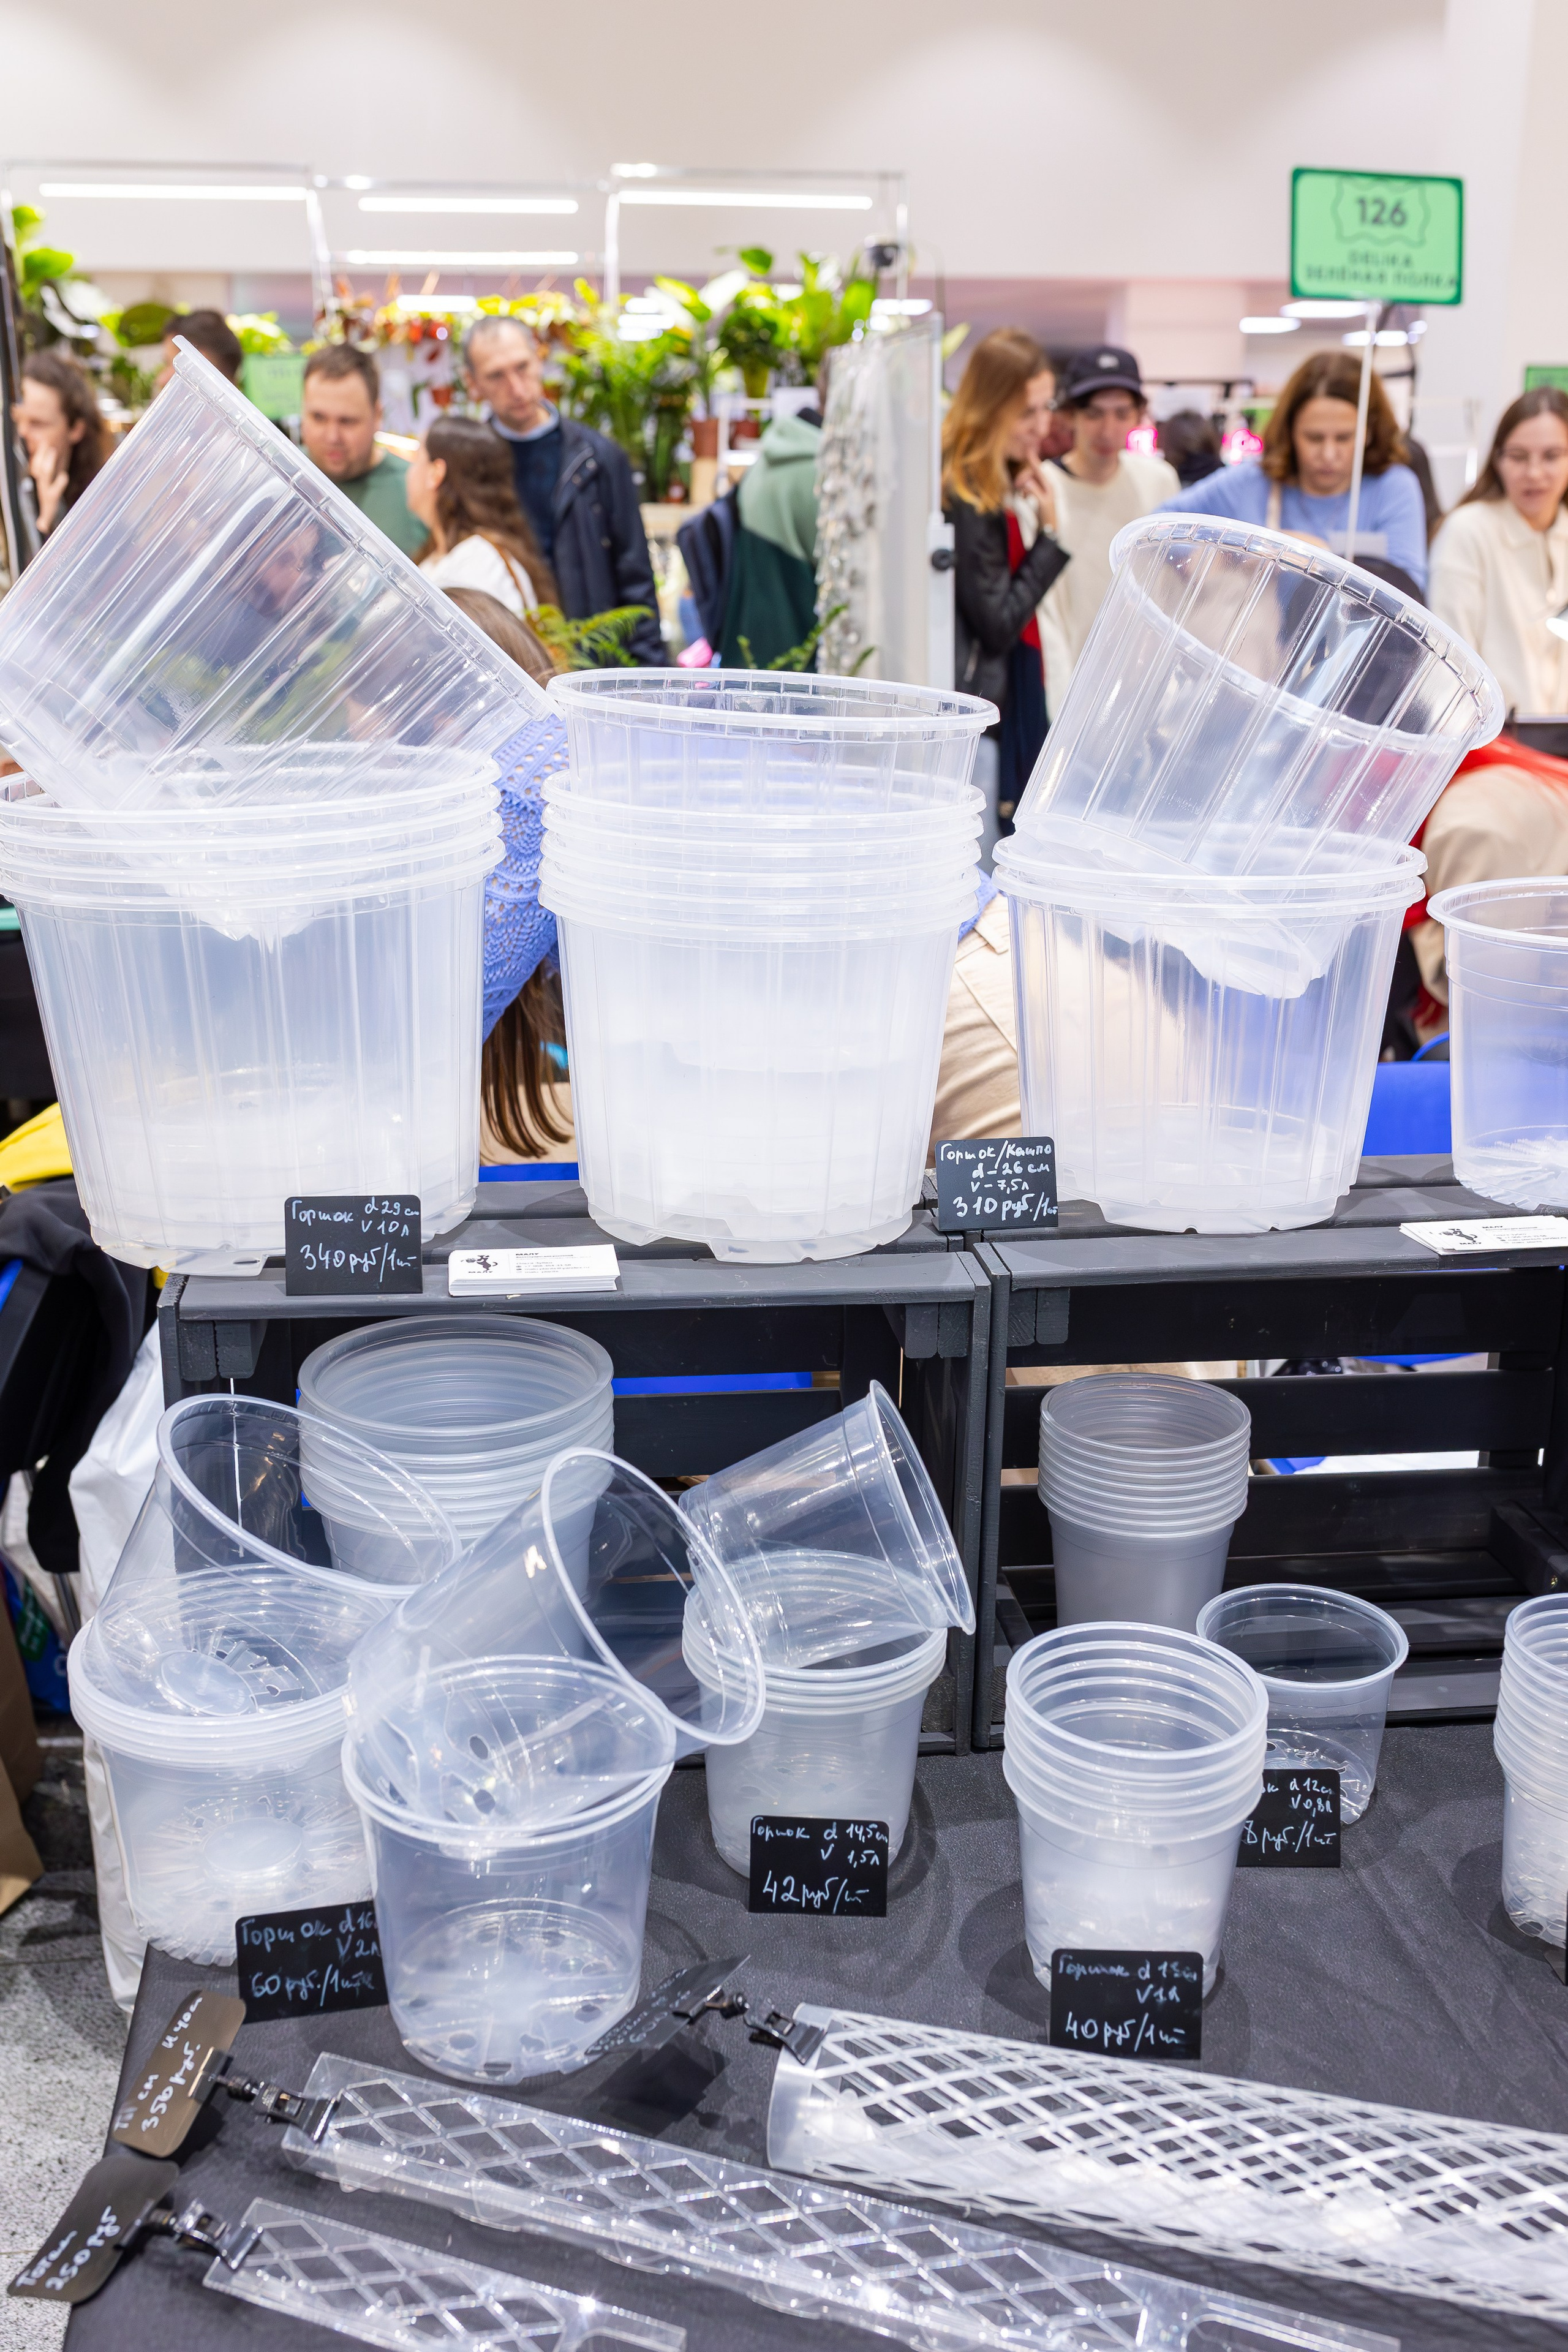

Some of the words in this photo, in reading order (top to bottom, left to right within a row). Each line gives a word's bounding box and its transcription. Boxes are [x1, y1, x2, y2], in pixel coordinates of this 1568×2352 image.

[1357, 197, 1408, 227] 126
[292, 1200, 353, 1226] Горшок
[300, 1243, 345, 1270] 340
[752, 1816, 810, 1841] Горшок
[251, 1972, 282, 1998] 60
[1066, 2011, 1098, 2039] 40
